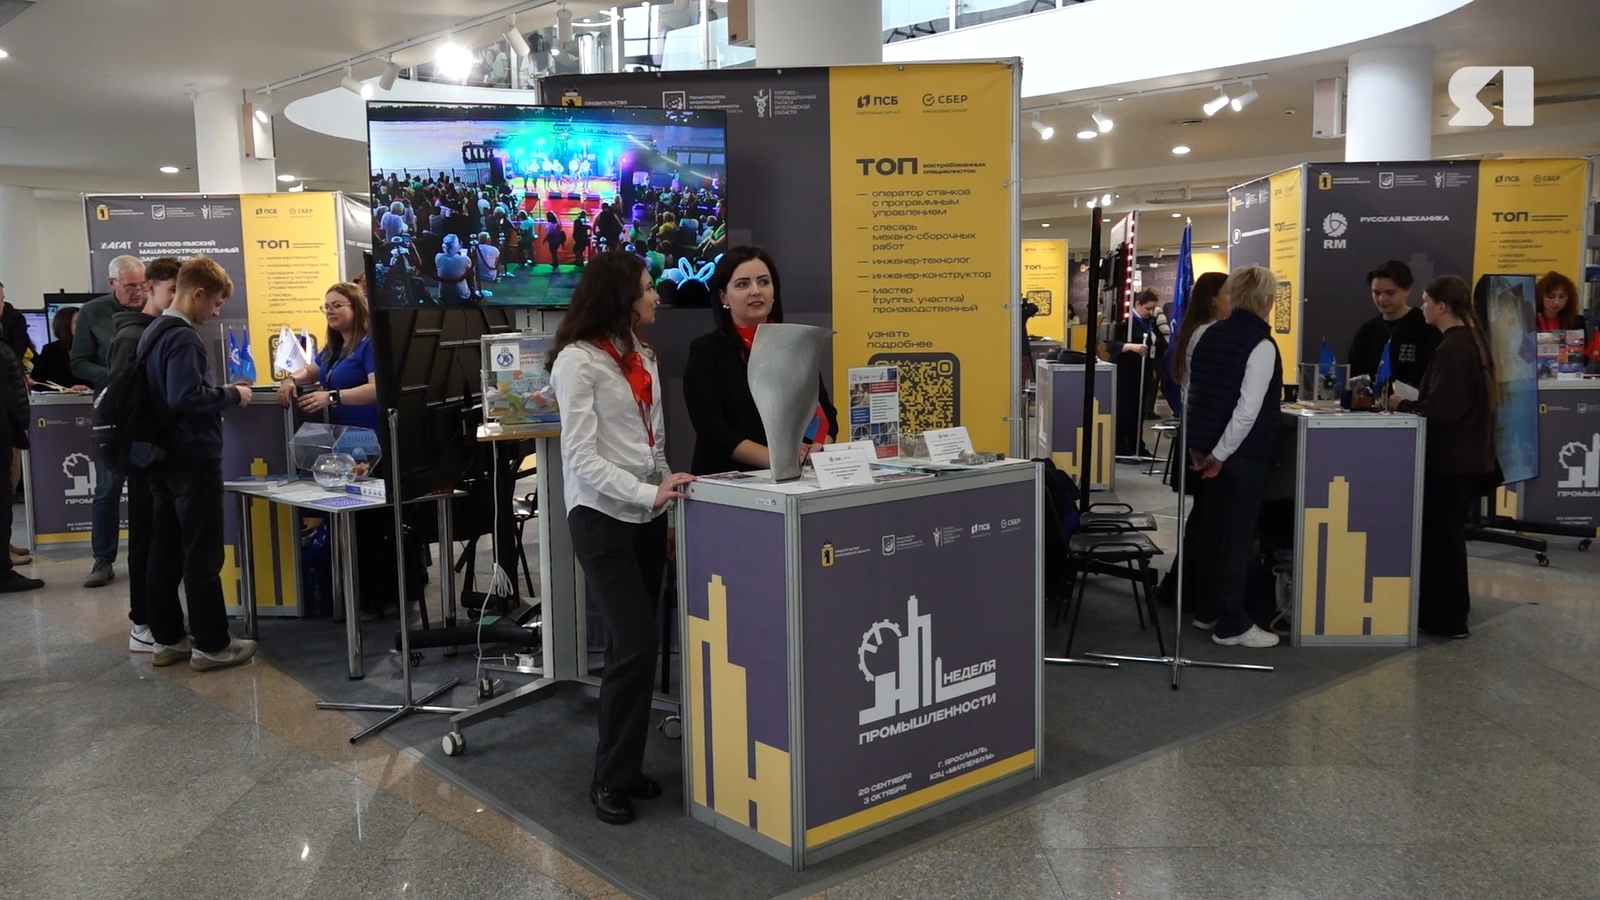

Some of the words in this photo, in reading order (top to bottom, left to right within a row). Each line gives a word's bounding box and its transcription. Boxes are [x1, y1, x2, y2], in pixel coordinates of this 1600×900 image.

[873, 96, 899, 106] ПСБ
[938, 94, 968, 104] СБЕР
[856, 158, 918, 176] ТОП
[872, 190, 924, 198] оператор
[881, 199, 960, 208] программным
[872, 208, 947, 218] управлением
[1492, 212, 1529, 222] ТОП
[872, 224, 918, 232] слесарь
[872, 232, 976, 241] механо-сборочных
[256, 240, 290, 249] ТОП
[872, 243, 904, 251] работ
[1323, 239, 1347, 249] RM
[872, 257, 971, 265] инженер-технолог
[872, 272, 992, 280] инженер-конструктор
[872, 287, 913, 295] мастер
[917, 294, 965, 304] участка)
[872, 304, 978, 314] производственный
[866, 330, 910, 340] узнать
[866, 340, 933, 350] подробнее
[978, 522, 990, 532] ПСБ
[944, 658, 996, 685] НЕДЕЛЯ
[858, 693, 996, 746] ПРОМЫШЛЕННОСТИ
[930, 770, 944, 781] КЗЦ
[945, 753, 995, 774] «МИЛЛЕНИУМ»
[858, 788, 870, 796] 29
[870, 772, 912, 792] СЕНТЯБРЯ
[870, 784, 907, 802] ОКТЯБРЯ
